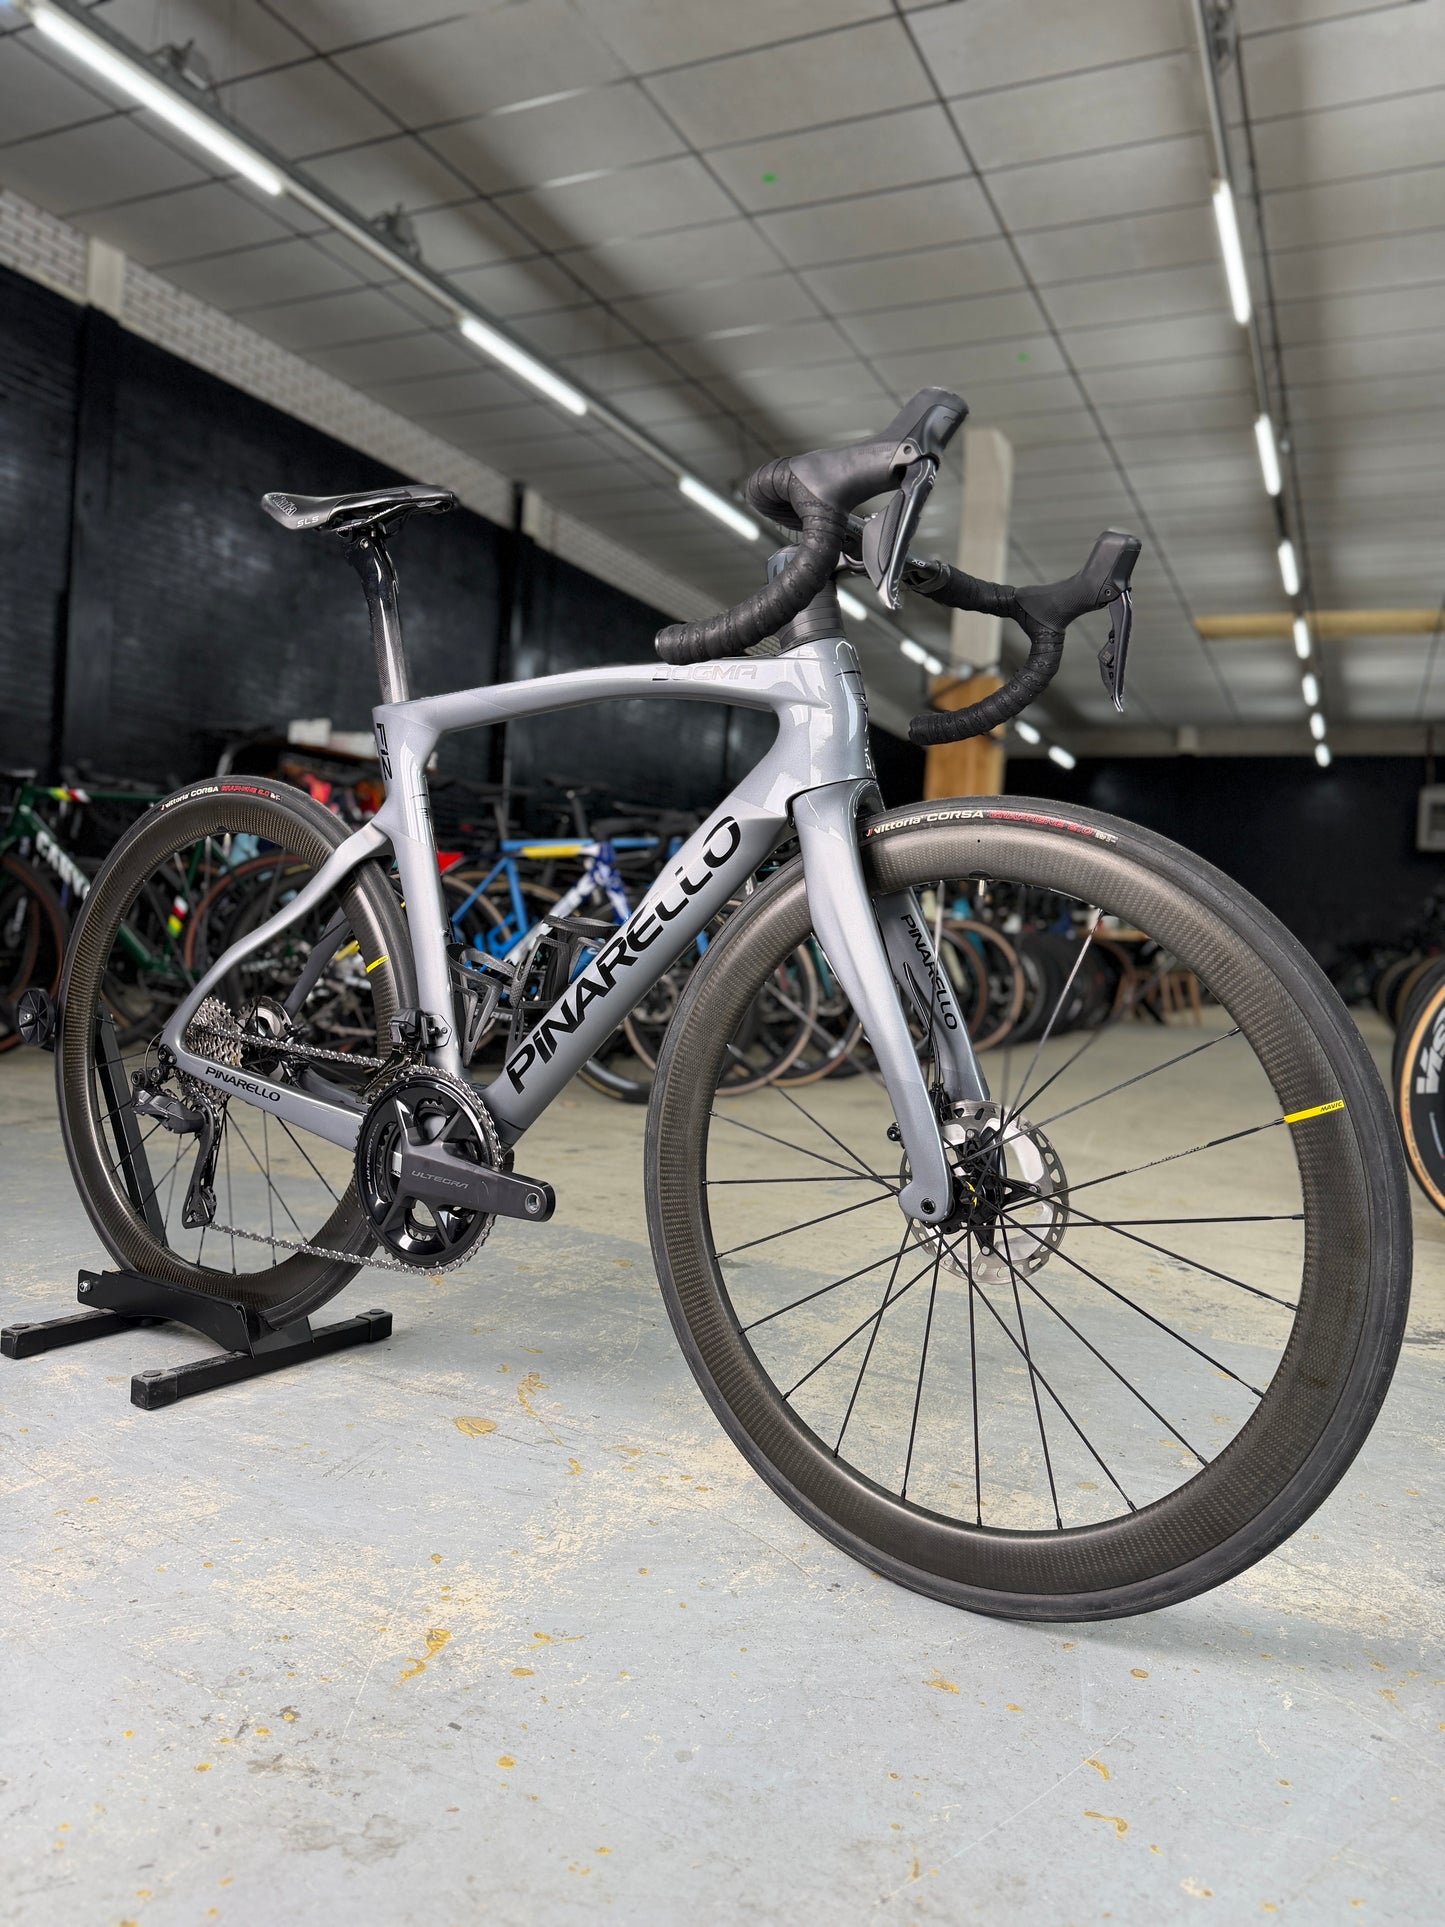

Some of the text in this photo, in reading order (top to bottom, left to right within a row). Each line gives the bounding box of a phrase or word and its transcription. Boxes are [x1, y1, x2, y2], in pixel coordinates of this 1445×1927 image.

[297, 515, 319, 528] SLS
[652, 665, 758, 681] DOGMA
[190, 786, 219, 797] CORSA
[926, 809, 984, 822] CORSA
[505, 815, 741, 1095] PINARELLO
[900, 913, 958, 1031] PINARELLO
[205, 1066, 281, 1102] PINARELLO
[1320, 1100, 1343, 1112] MAVIC
[411, 1170, 469, 1189] ULTEGRA
